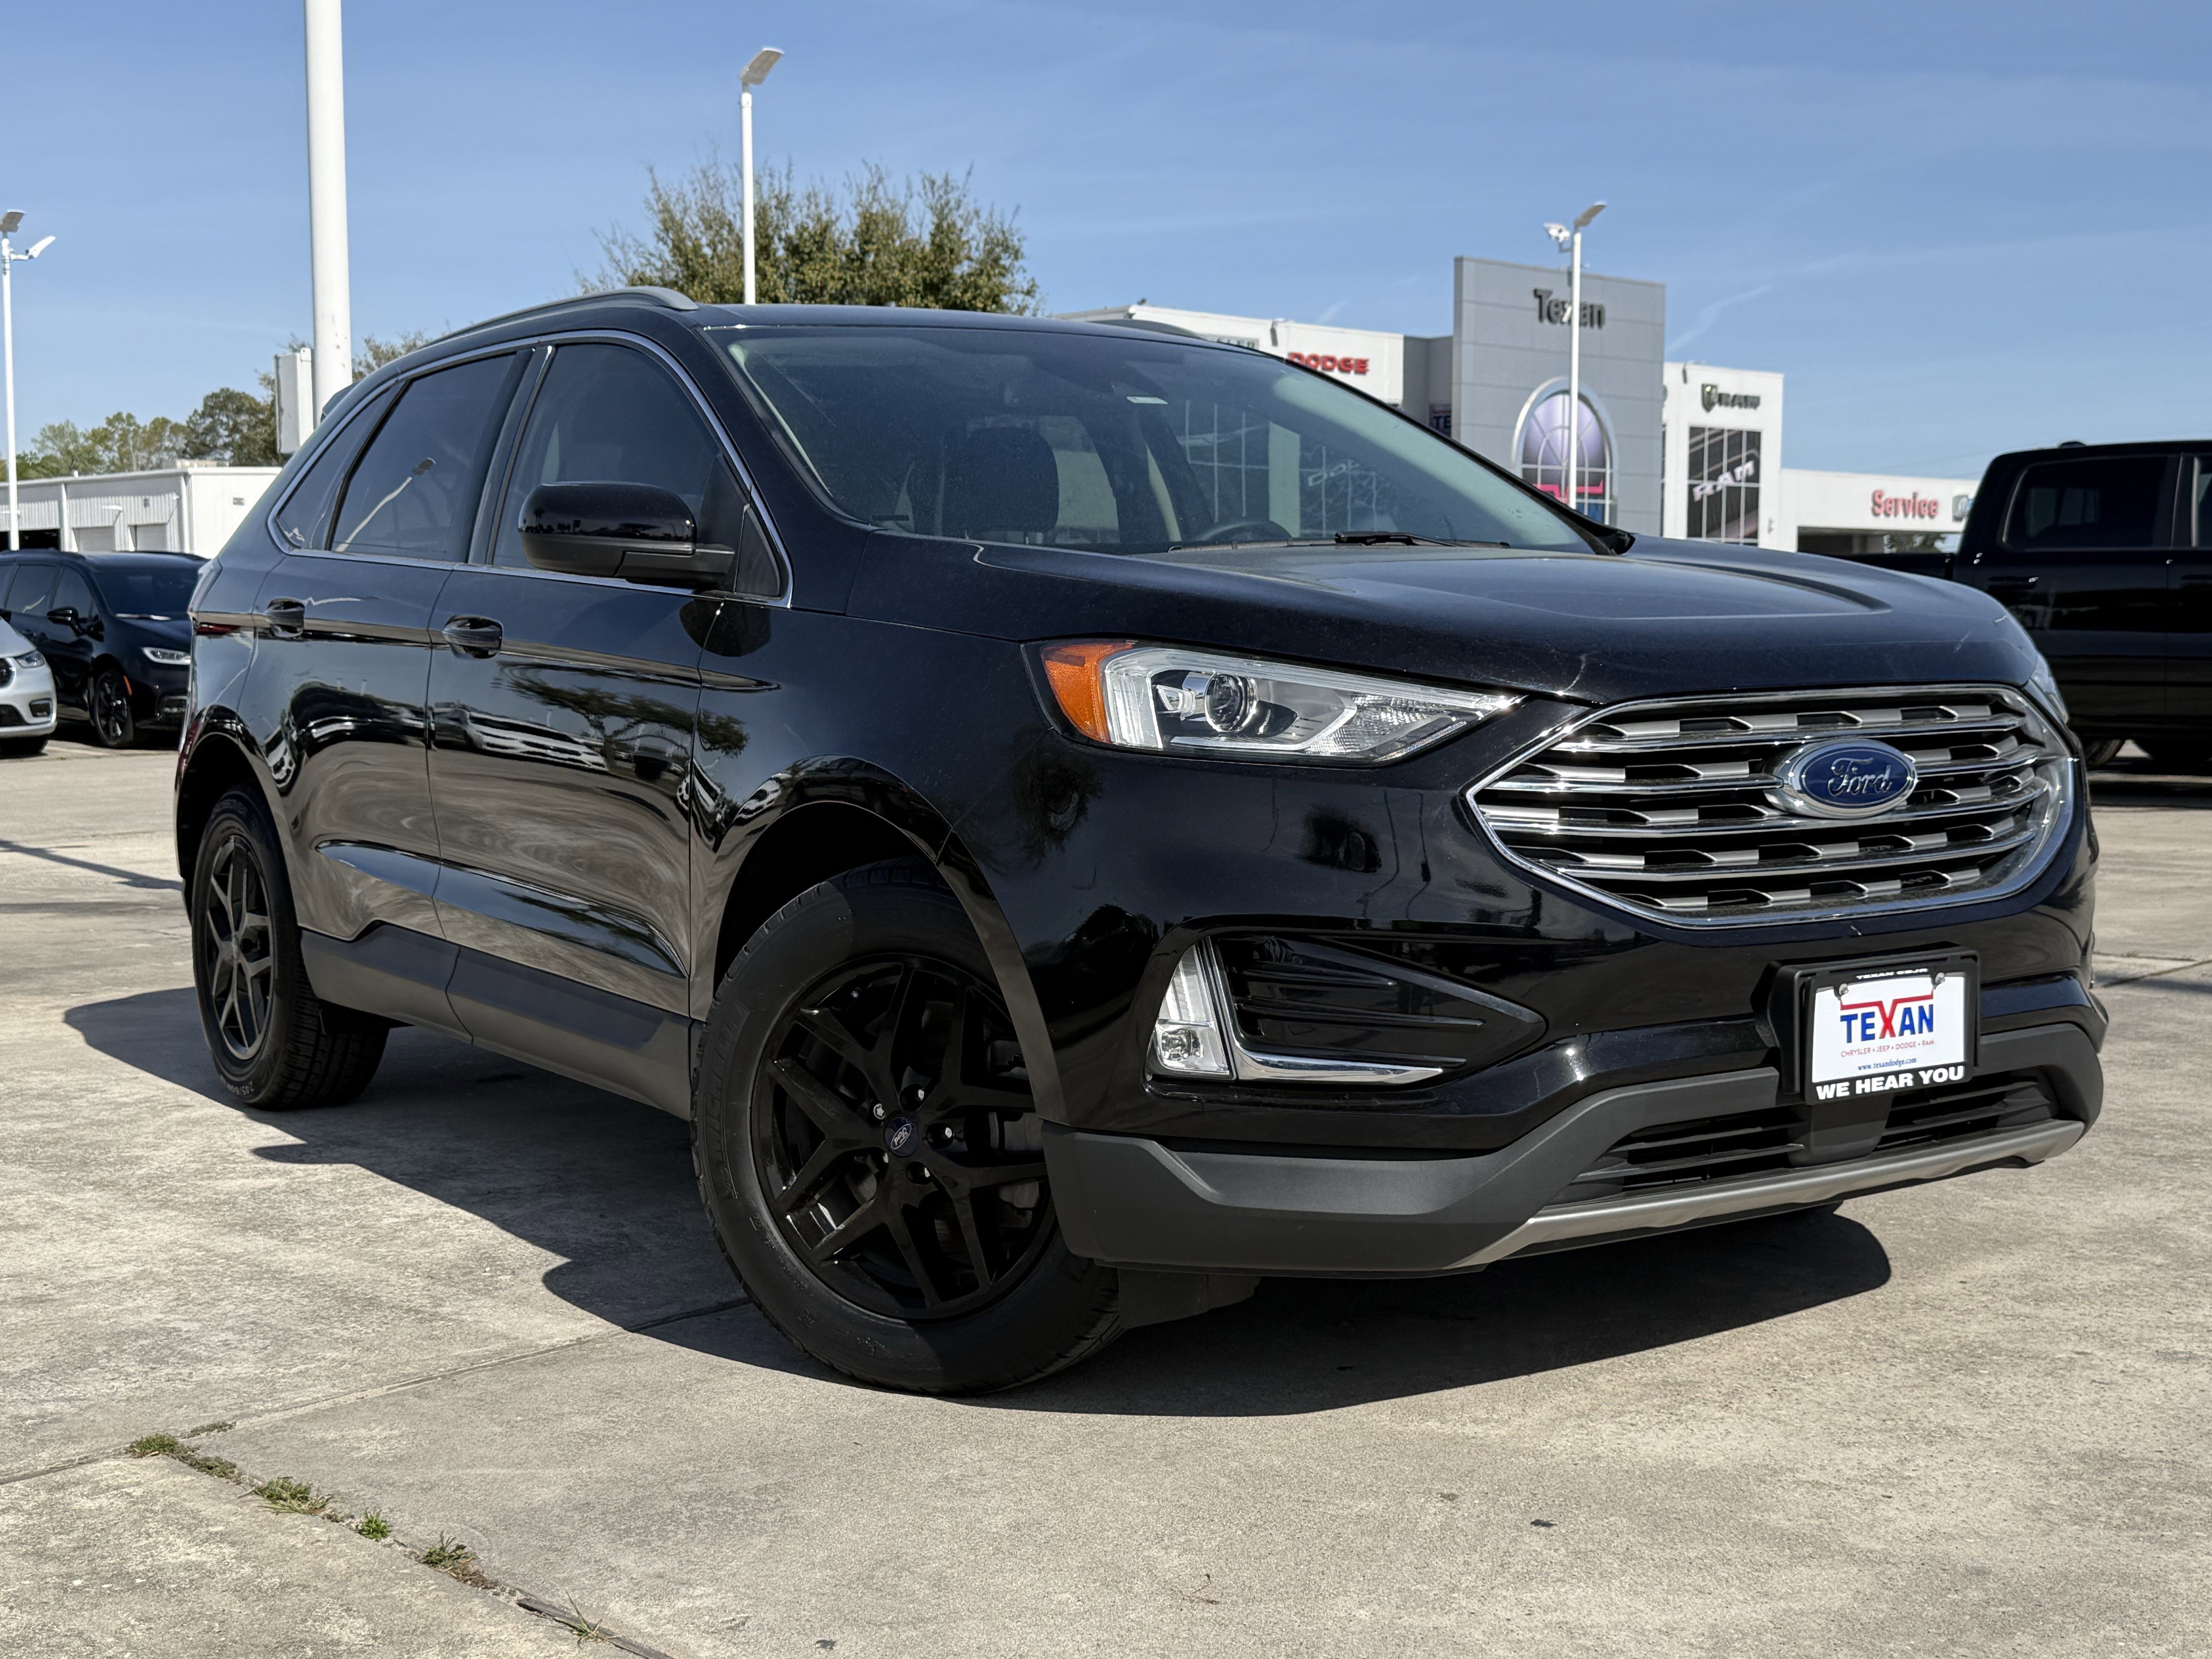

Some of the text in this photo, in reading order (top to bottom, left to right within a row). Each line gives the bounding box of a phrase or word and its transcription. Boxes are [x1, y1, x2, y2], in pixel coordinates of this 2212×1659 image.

[1288, 352, 1370, 375] DODGE
[1693, 460, 1754, 502] RAM
[1872, 489, 1939, 519] Service
[1827, 757, 1893, 797] Ford
[1840, 998, 1934, 1044] TEXAN
[1841, 1047, 1871, 1058] CHRYSLER
[1895, 1041, 1916, 1050] DODGE
[1857, 1057, 1917, 1071] www.texandodge.com
[1816, 1065, 1964, 1100] WE HEAR YOU
[893, 1127, 908, 1146] Ford
